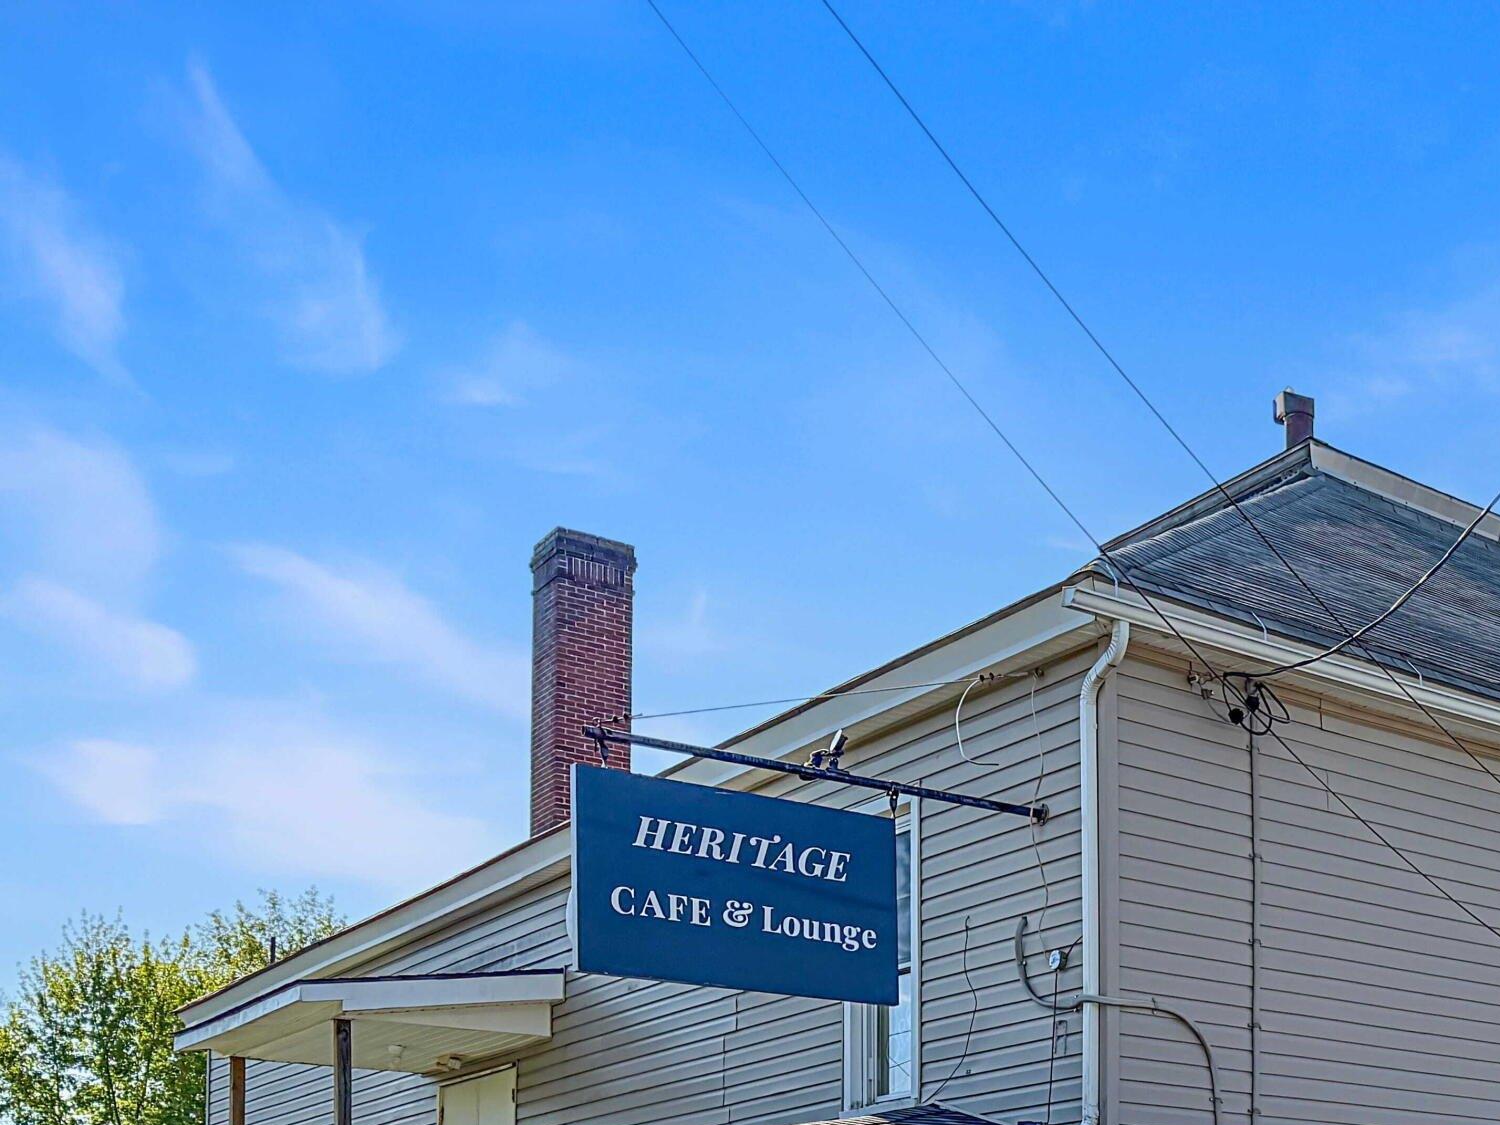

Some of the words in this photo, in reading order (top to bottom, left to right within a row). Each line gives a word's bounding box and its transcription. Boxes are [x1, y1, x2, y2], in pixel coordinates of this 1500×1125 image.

[632, 815, 851, 883] HERITAGE
[610, 886, 712, 927] CAFE
[722, 899, 754, 928] &
[761, 906, 878, 952] Lounge
